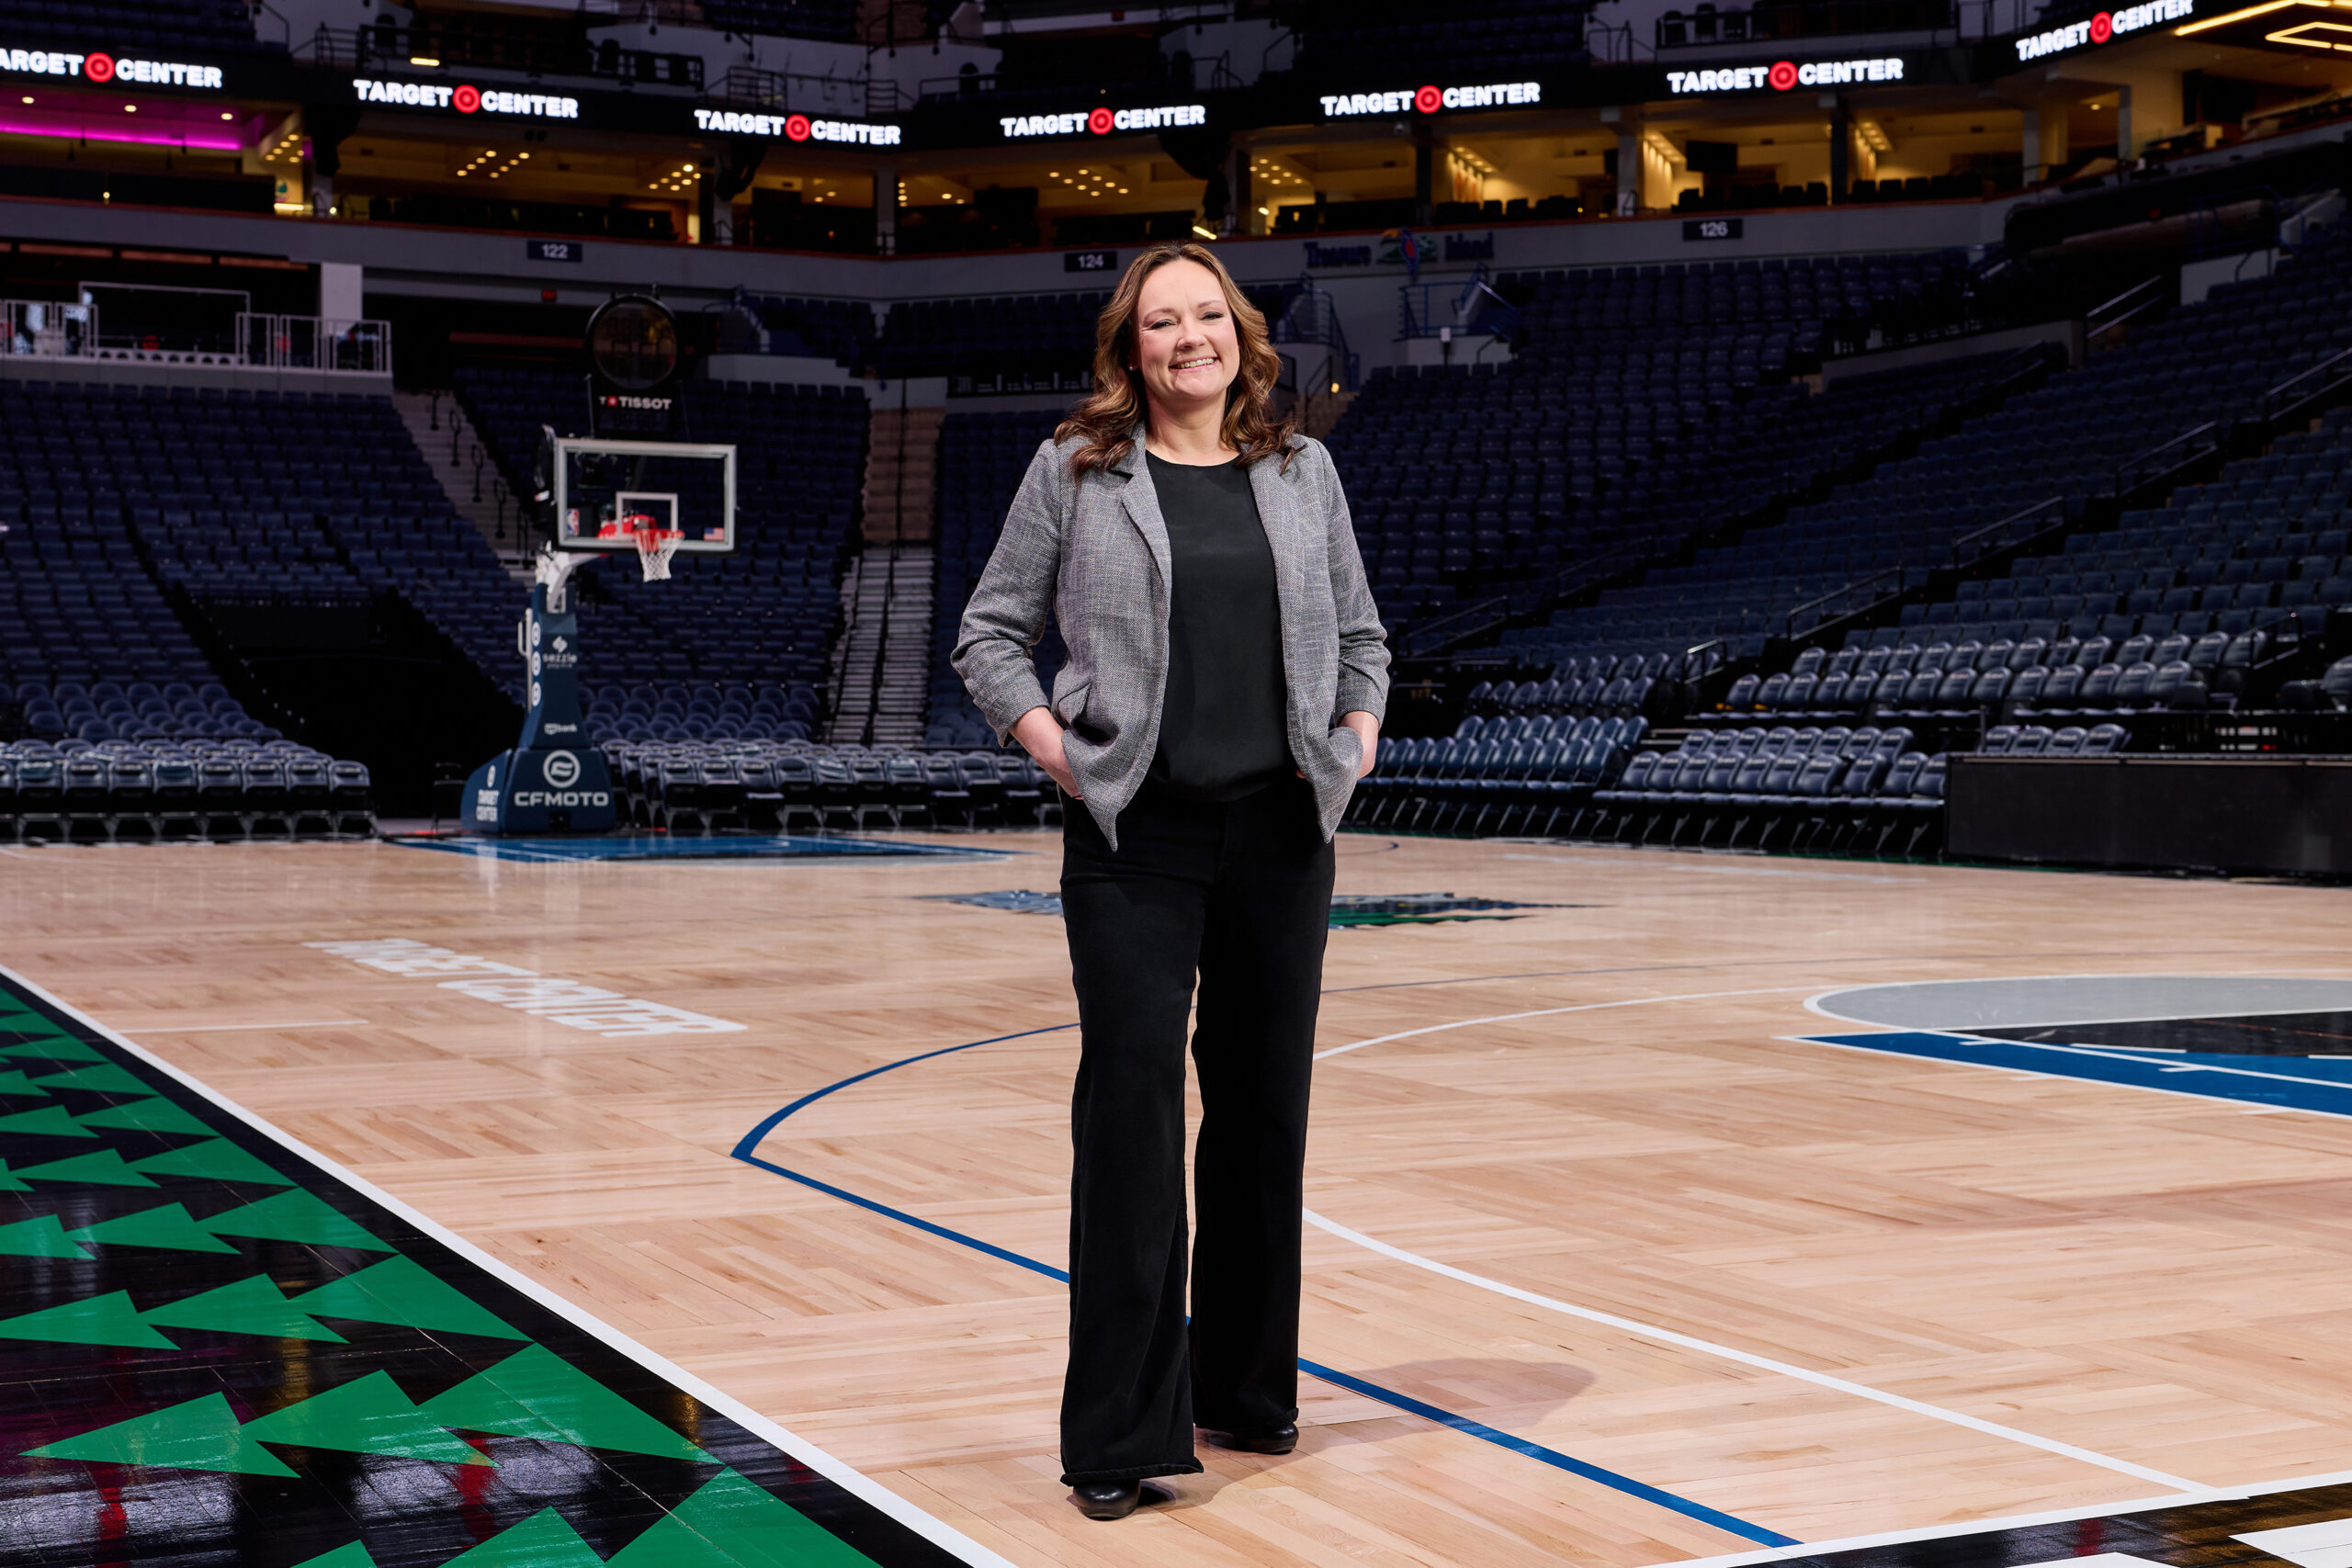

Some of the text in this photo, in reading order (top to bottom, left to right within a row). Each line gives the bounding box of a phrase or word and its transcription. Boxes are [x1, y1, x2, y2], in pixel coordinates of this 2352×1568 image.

[2015, 0, 2194, 62] TARGET CENTER
[0, 48, 223, 89] ARGET CENTER
[1666, 57, 1904, 94] TARGET CENTER
[352, 79, 579, 118] TARGET CENTER
[1319, 82, 1541, 117] TARGET CENTER
[694, 108, 901, 145] TARGET CENTER
[1000, 105, 1205, 137] TARGET CENTER
[1700, 221, 1728, 237] 126
[540, 243, 570, 259] 122
[1077, 254, 1104, 269] 124
[1302, 231, 1494, 268] Treasure Island
[618, 396, 673, 411] TISSOT
[514, 791, 609, 807] CFMOTO
